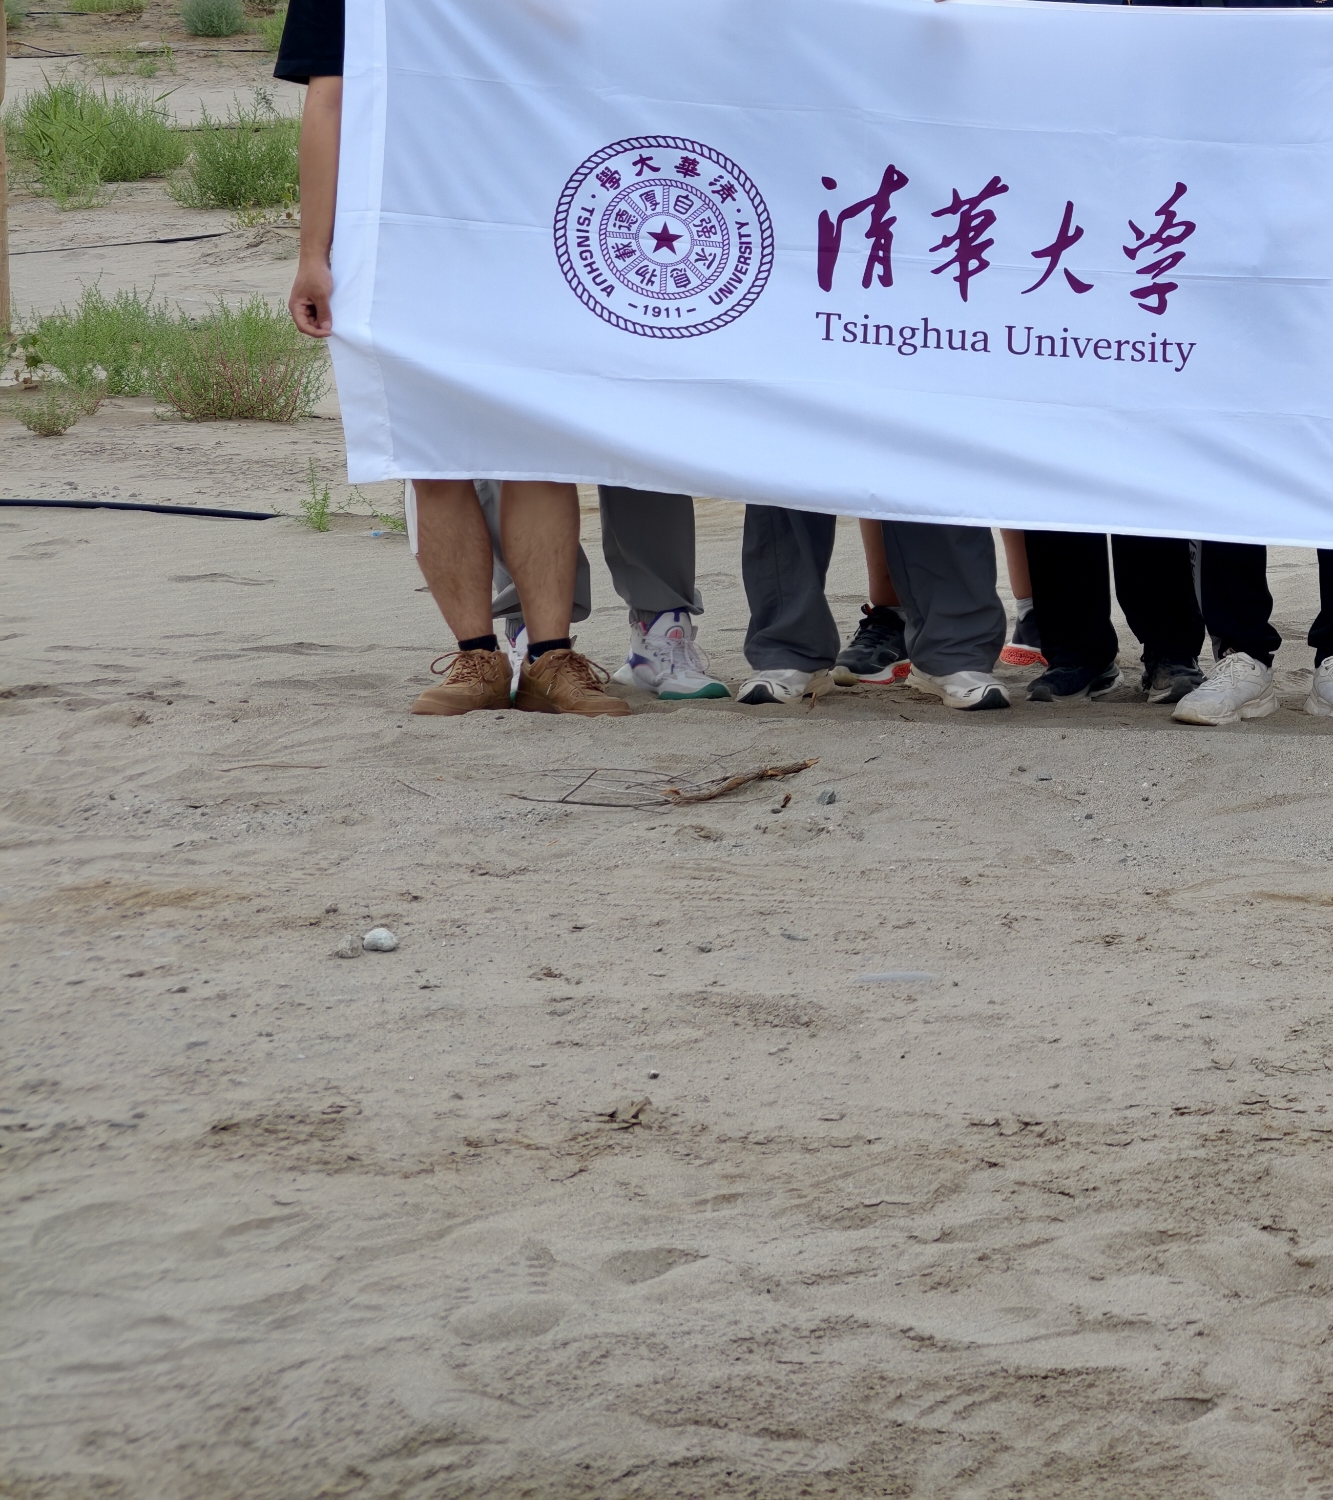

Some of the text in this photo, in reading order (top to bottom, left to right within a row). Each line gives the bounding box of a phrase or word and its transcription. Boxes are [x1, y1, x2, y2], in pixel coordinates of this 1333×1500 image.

[576, 206, 615, 298] TSINGHUA
[708, 220, 752, 305] UNIVERSITY
[816, 311, 1197, 372] Tsinghua University
